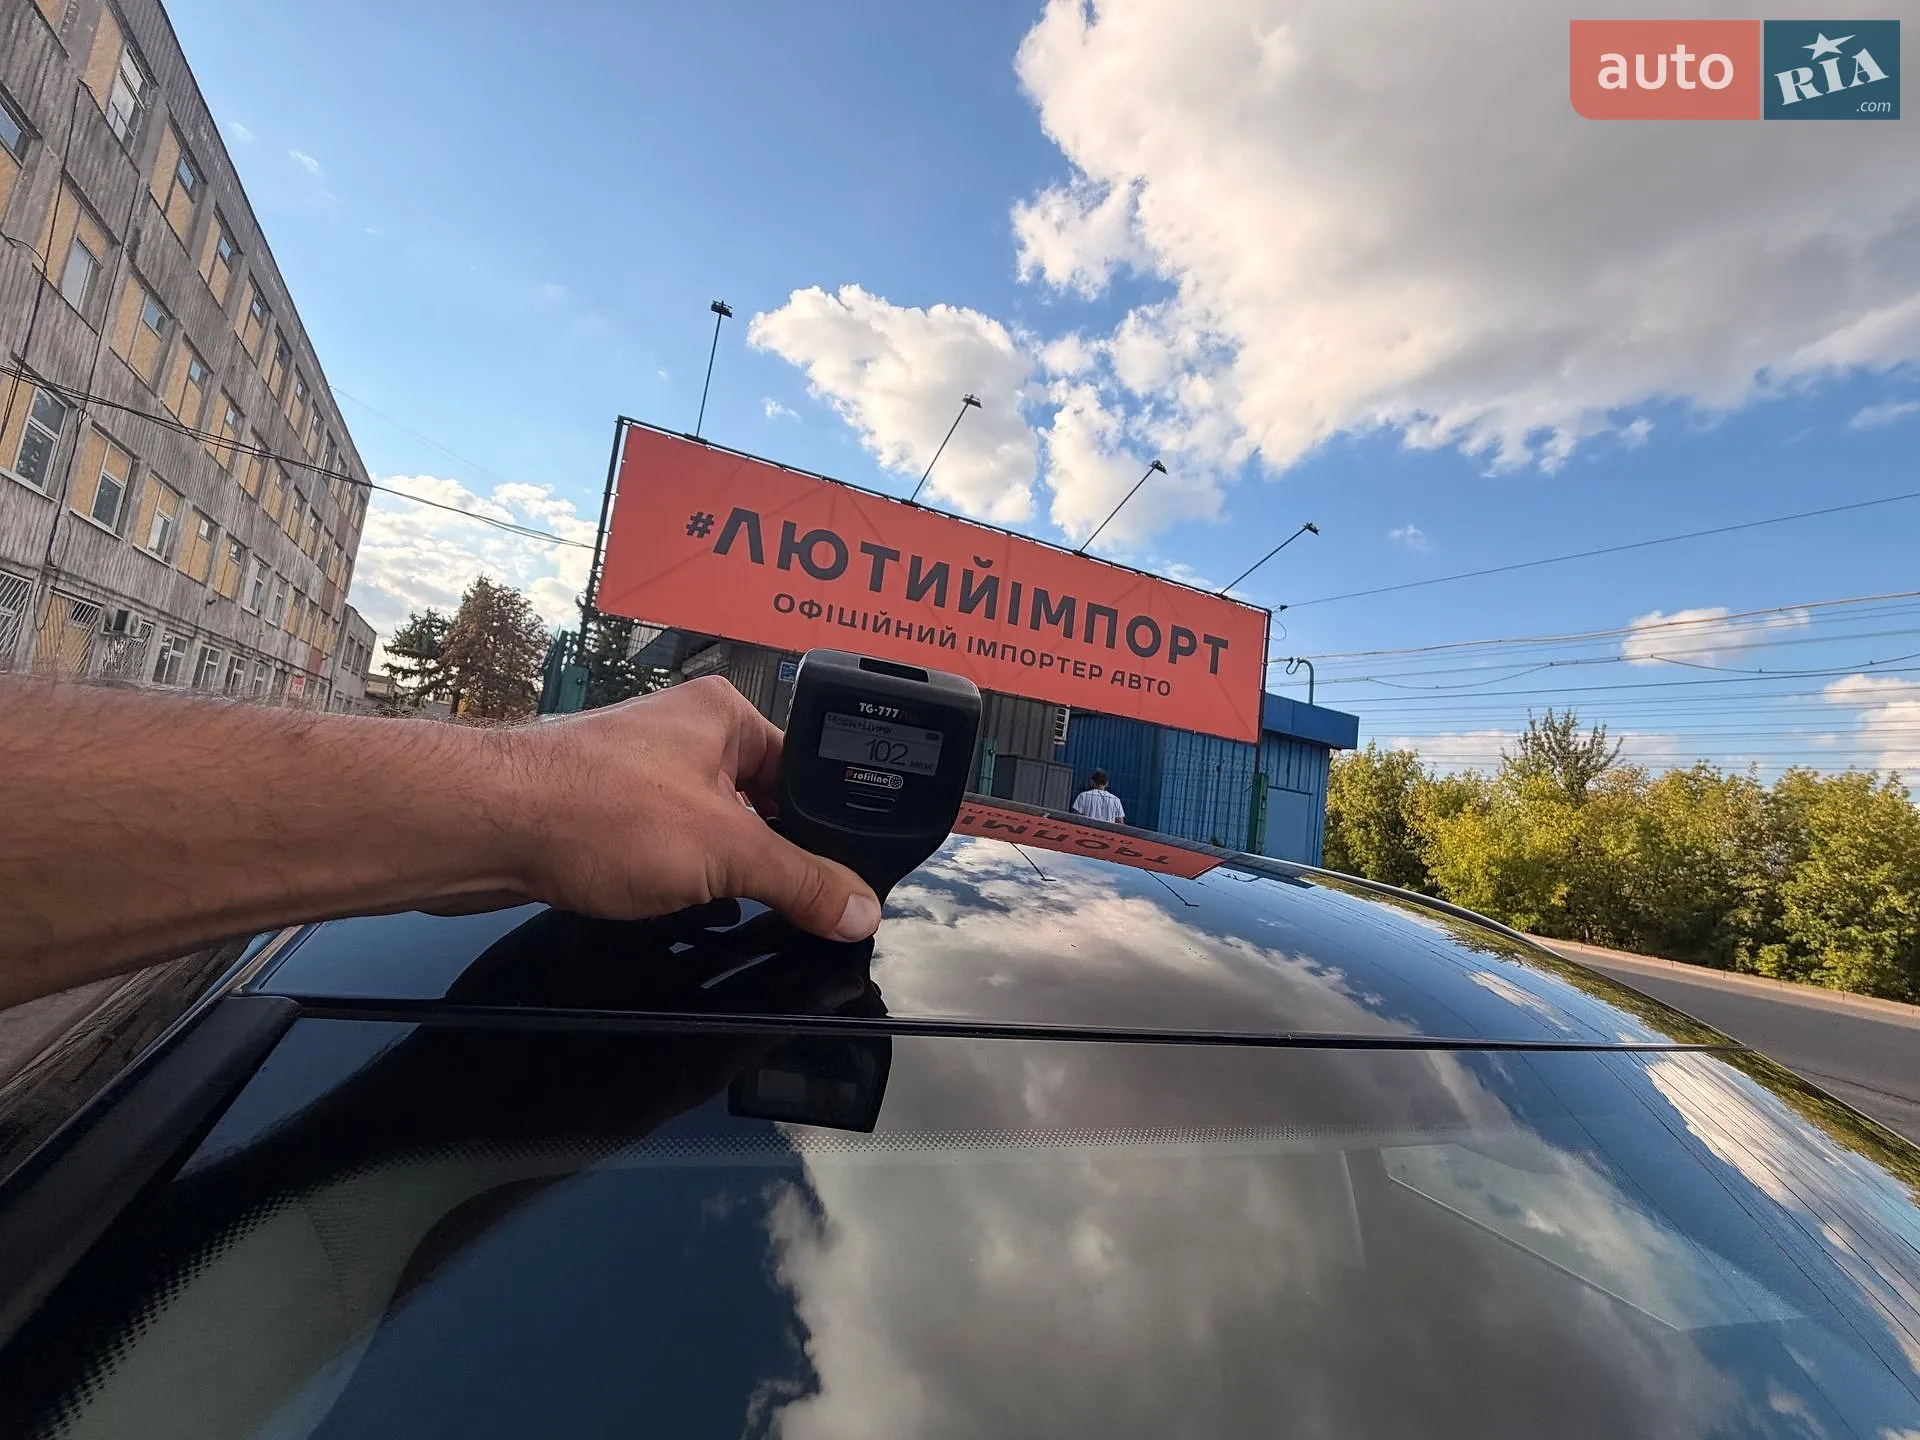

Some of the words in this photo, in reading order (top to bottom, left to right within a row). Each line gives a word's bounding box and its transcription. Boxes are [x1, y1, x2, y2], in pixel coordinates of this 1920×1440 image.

[686, 506, 1229, 675] #ЛЮТИЙІМПОРТ
[773, 592, 957, 650] ОФІЦІЙНИЙ
[967, 636, 1103, 680] ІМПОРТЕР
[1110, 670, 1172, 697] АВТО
[859, 702, 899, 718] TG-777
[865, 739, 908, 767] 102
[845, 769, 889, 784] Profiline
